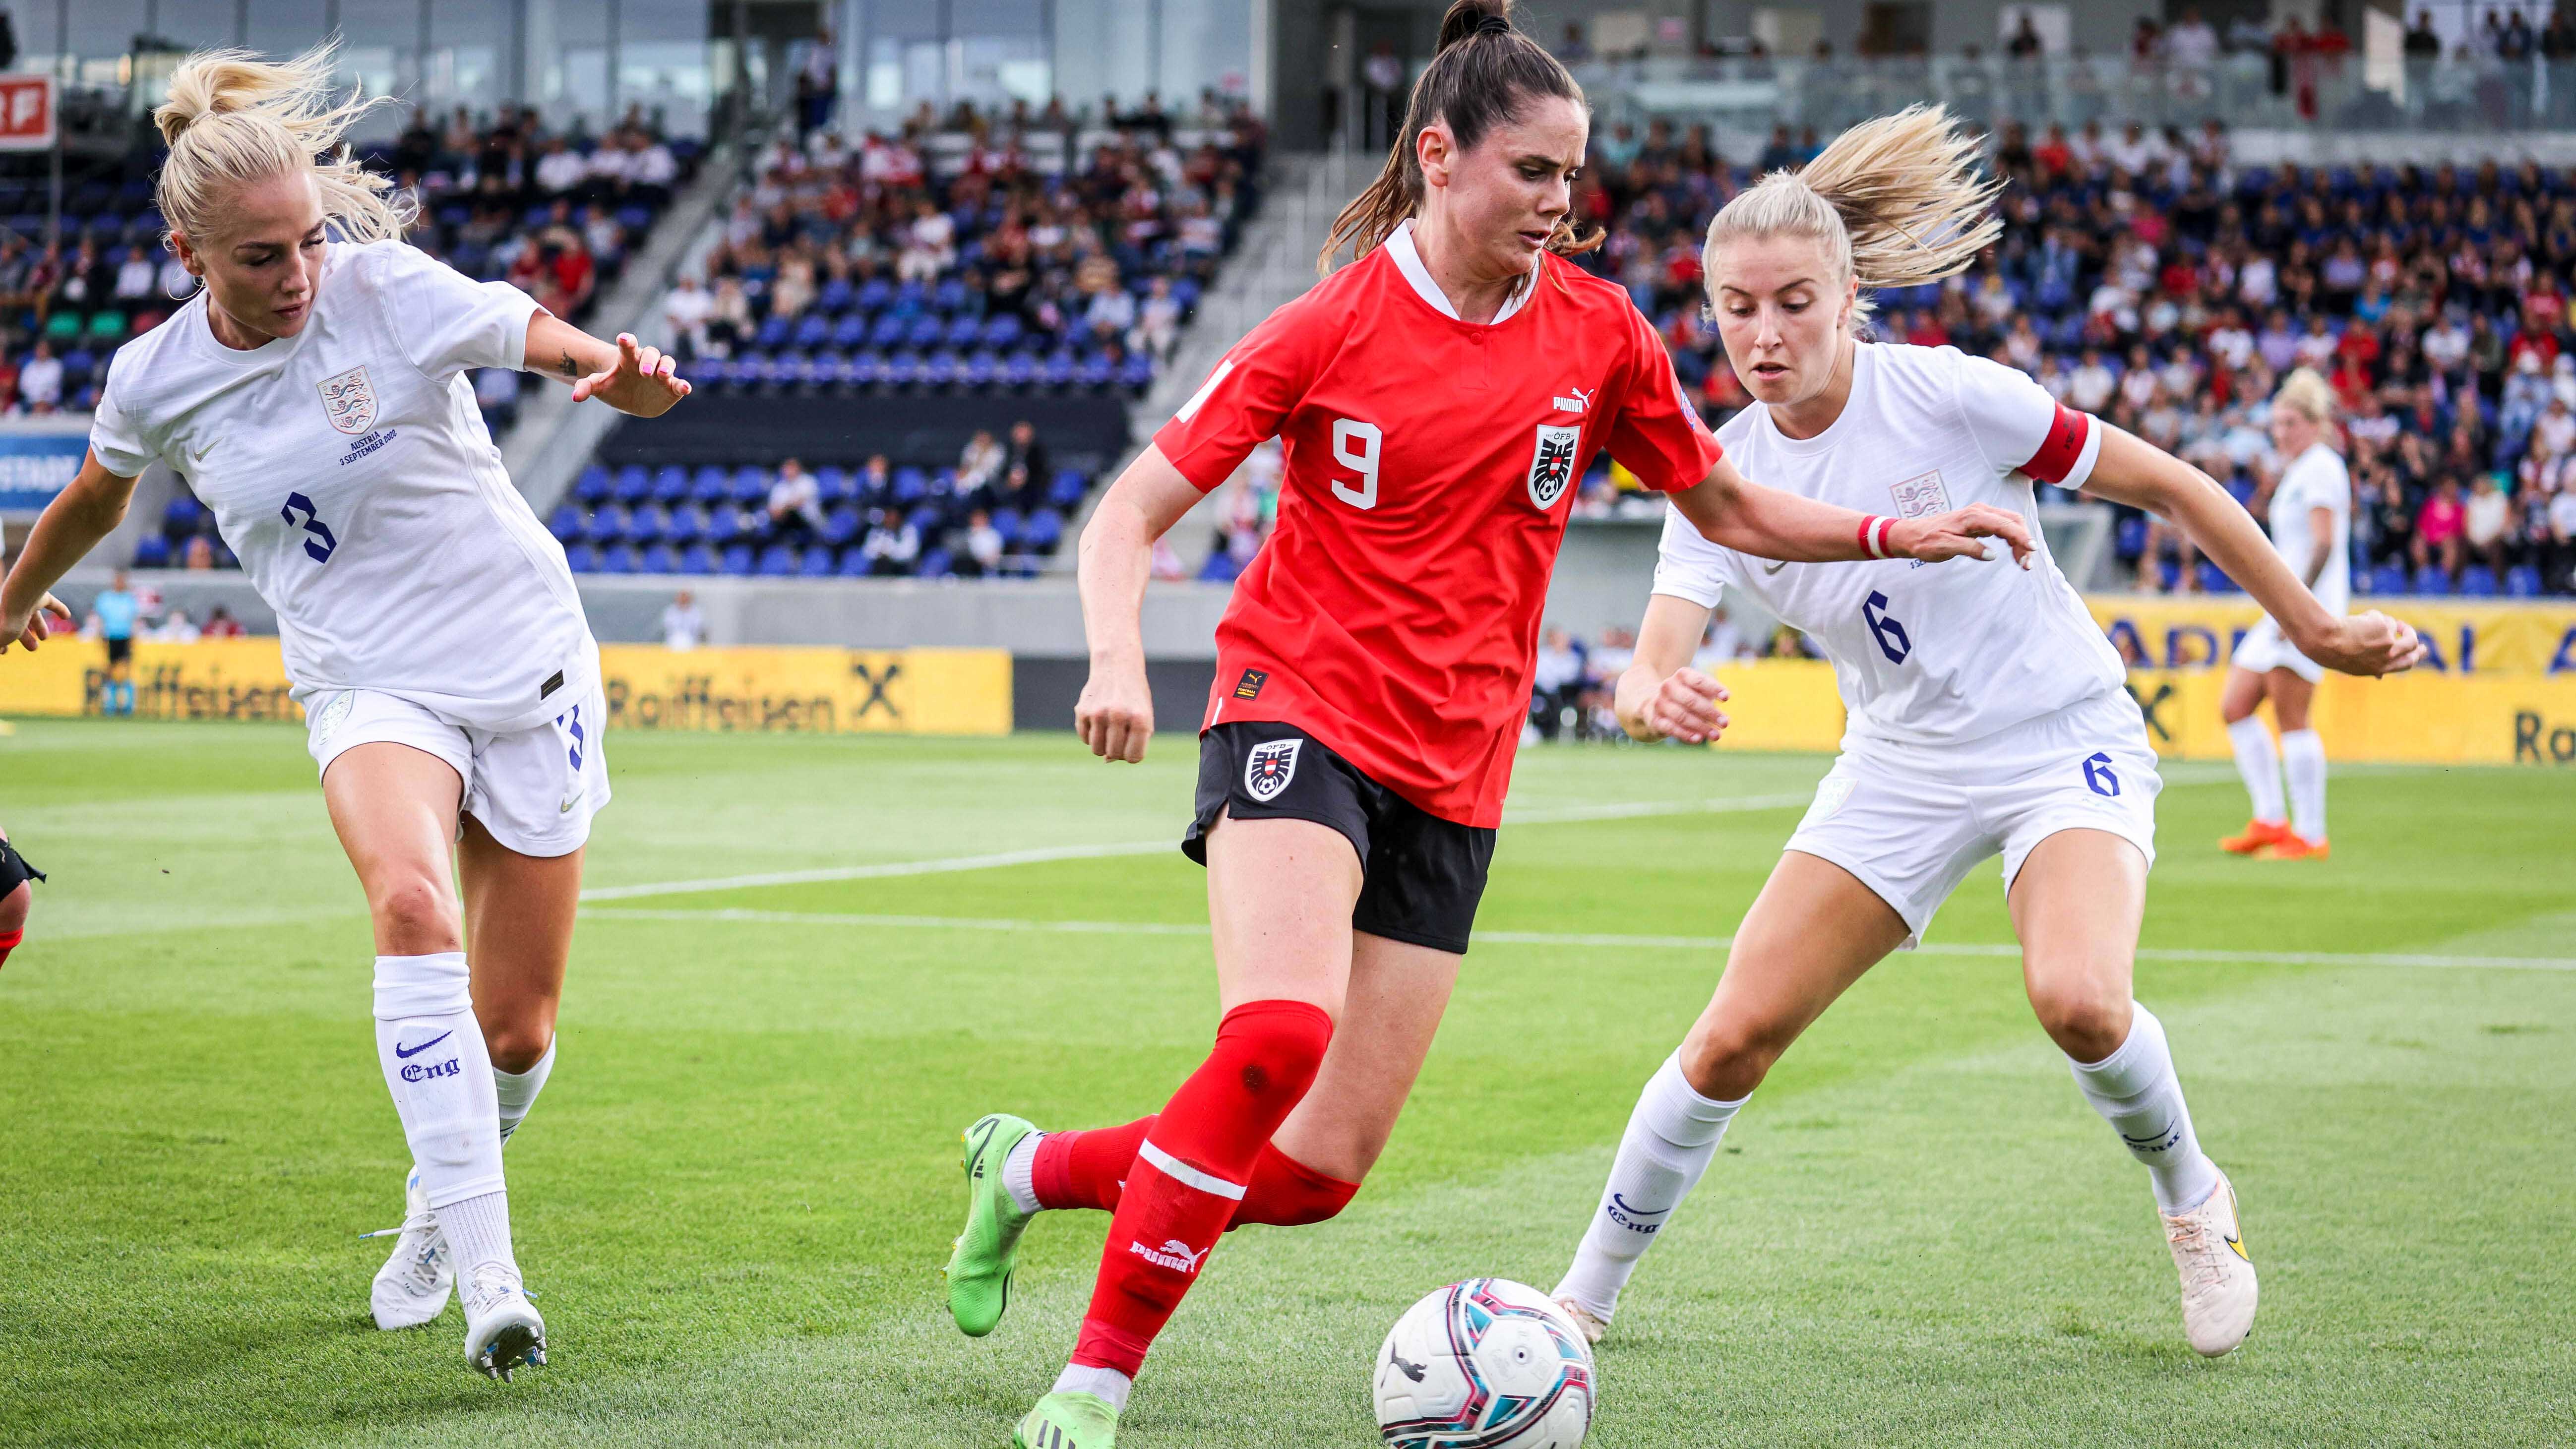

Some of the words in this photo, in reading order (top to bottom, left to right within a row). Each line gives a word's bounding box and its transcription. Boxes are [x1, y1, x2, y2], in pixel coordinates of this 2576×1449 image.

[1553, 396, 1583, 413] PUMA
[344, 438, 385, 464] SEPTEMBER
[383, 429, 397, 443] 2022
[350, 430, 381, 451] AUSTRIA
[1554, 431, 1571, 440] ÖFB
[1331, 418, 1383, 510] 9
[280, 491, 338, 564] 3
[1862, 590, 1912, 665] 6
[2082, 752, 2120, 796] 6
[400, 1057, 461, 1083] Eng
[1607, 1205, 1660, 1234] Eng
[1129, 1240, 1191, 1273] PUMA
